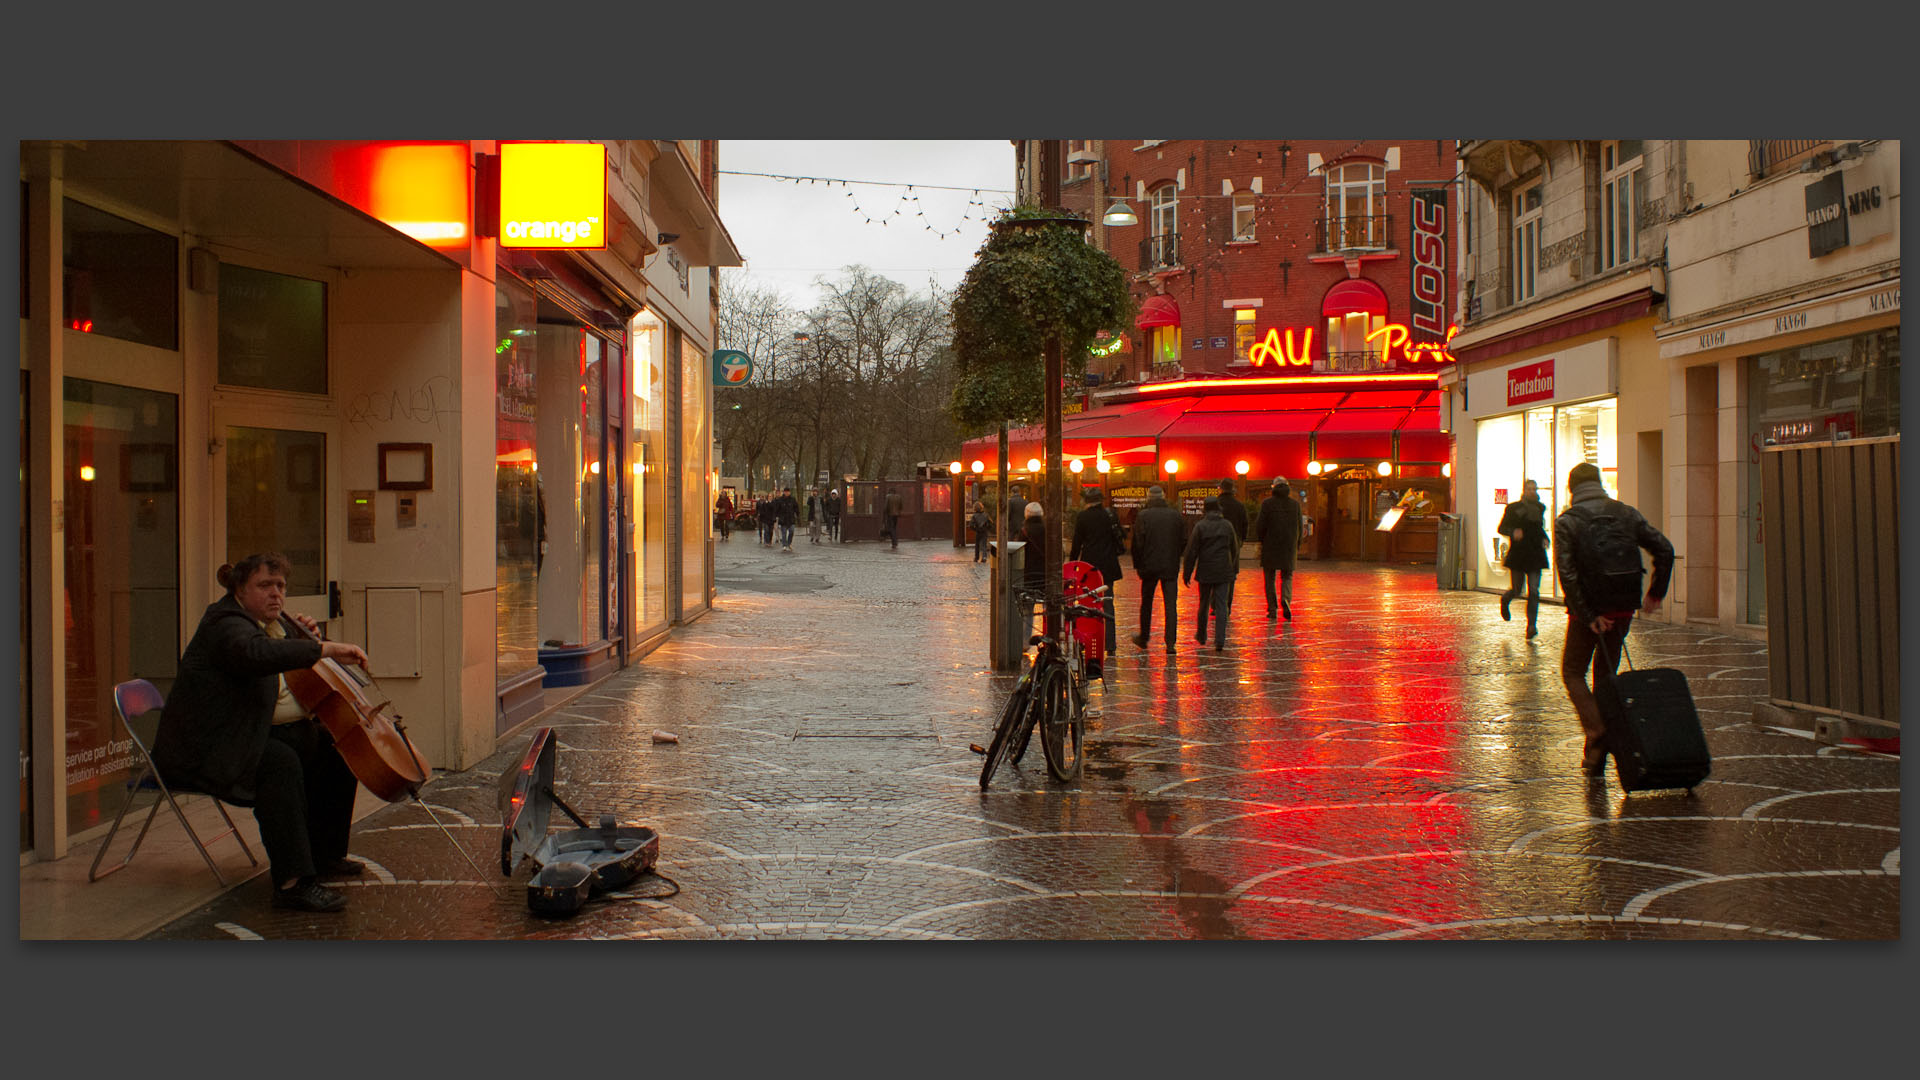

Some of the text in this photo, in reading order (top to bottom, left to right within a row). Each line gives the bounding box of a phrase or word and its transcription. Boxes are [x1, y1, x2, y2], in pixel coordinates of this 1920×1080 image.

[1807, 203, 1840, 227] MANGO
[1848, 186, 1881, 216] MNG
[1413, 197, 1444, 335] LOSC
[1774, 312, 1807, 333] MANGO
[1248, 327, 1314, 367] AU
[1698, 330, 1726, 349] MANGO
[1508, 367, 1553, 399] Tentation
[66, 738, 133, 768] service par Orange
